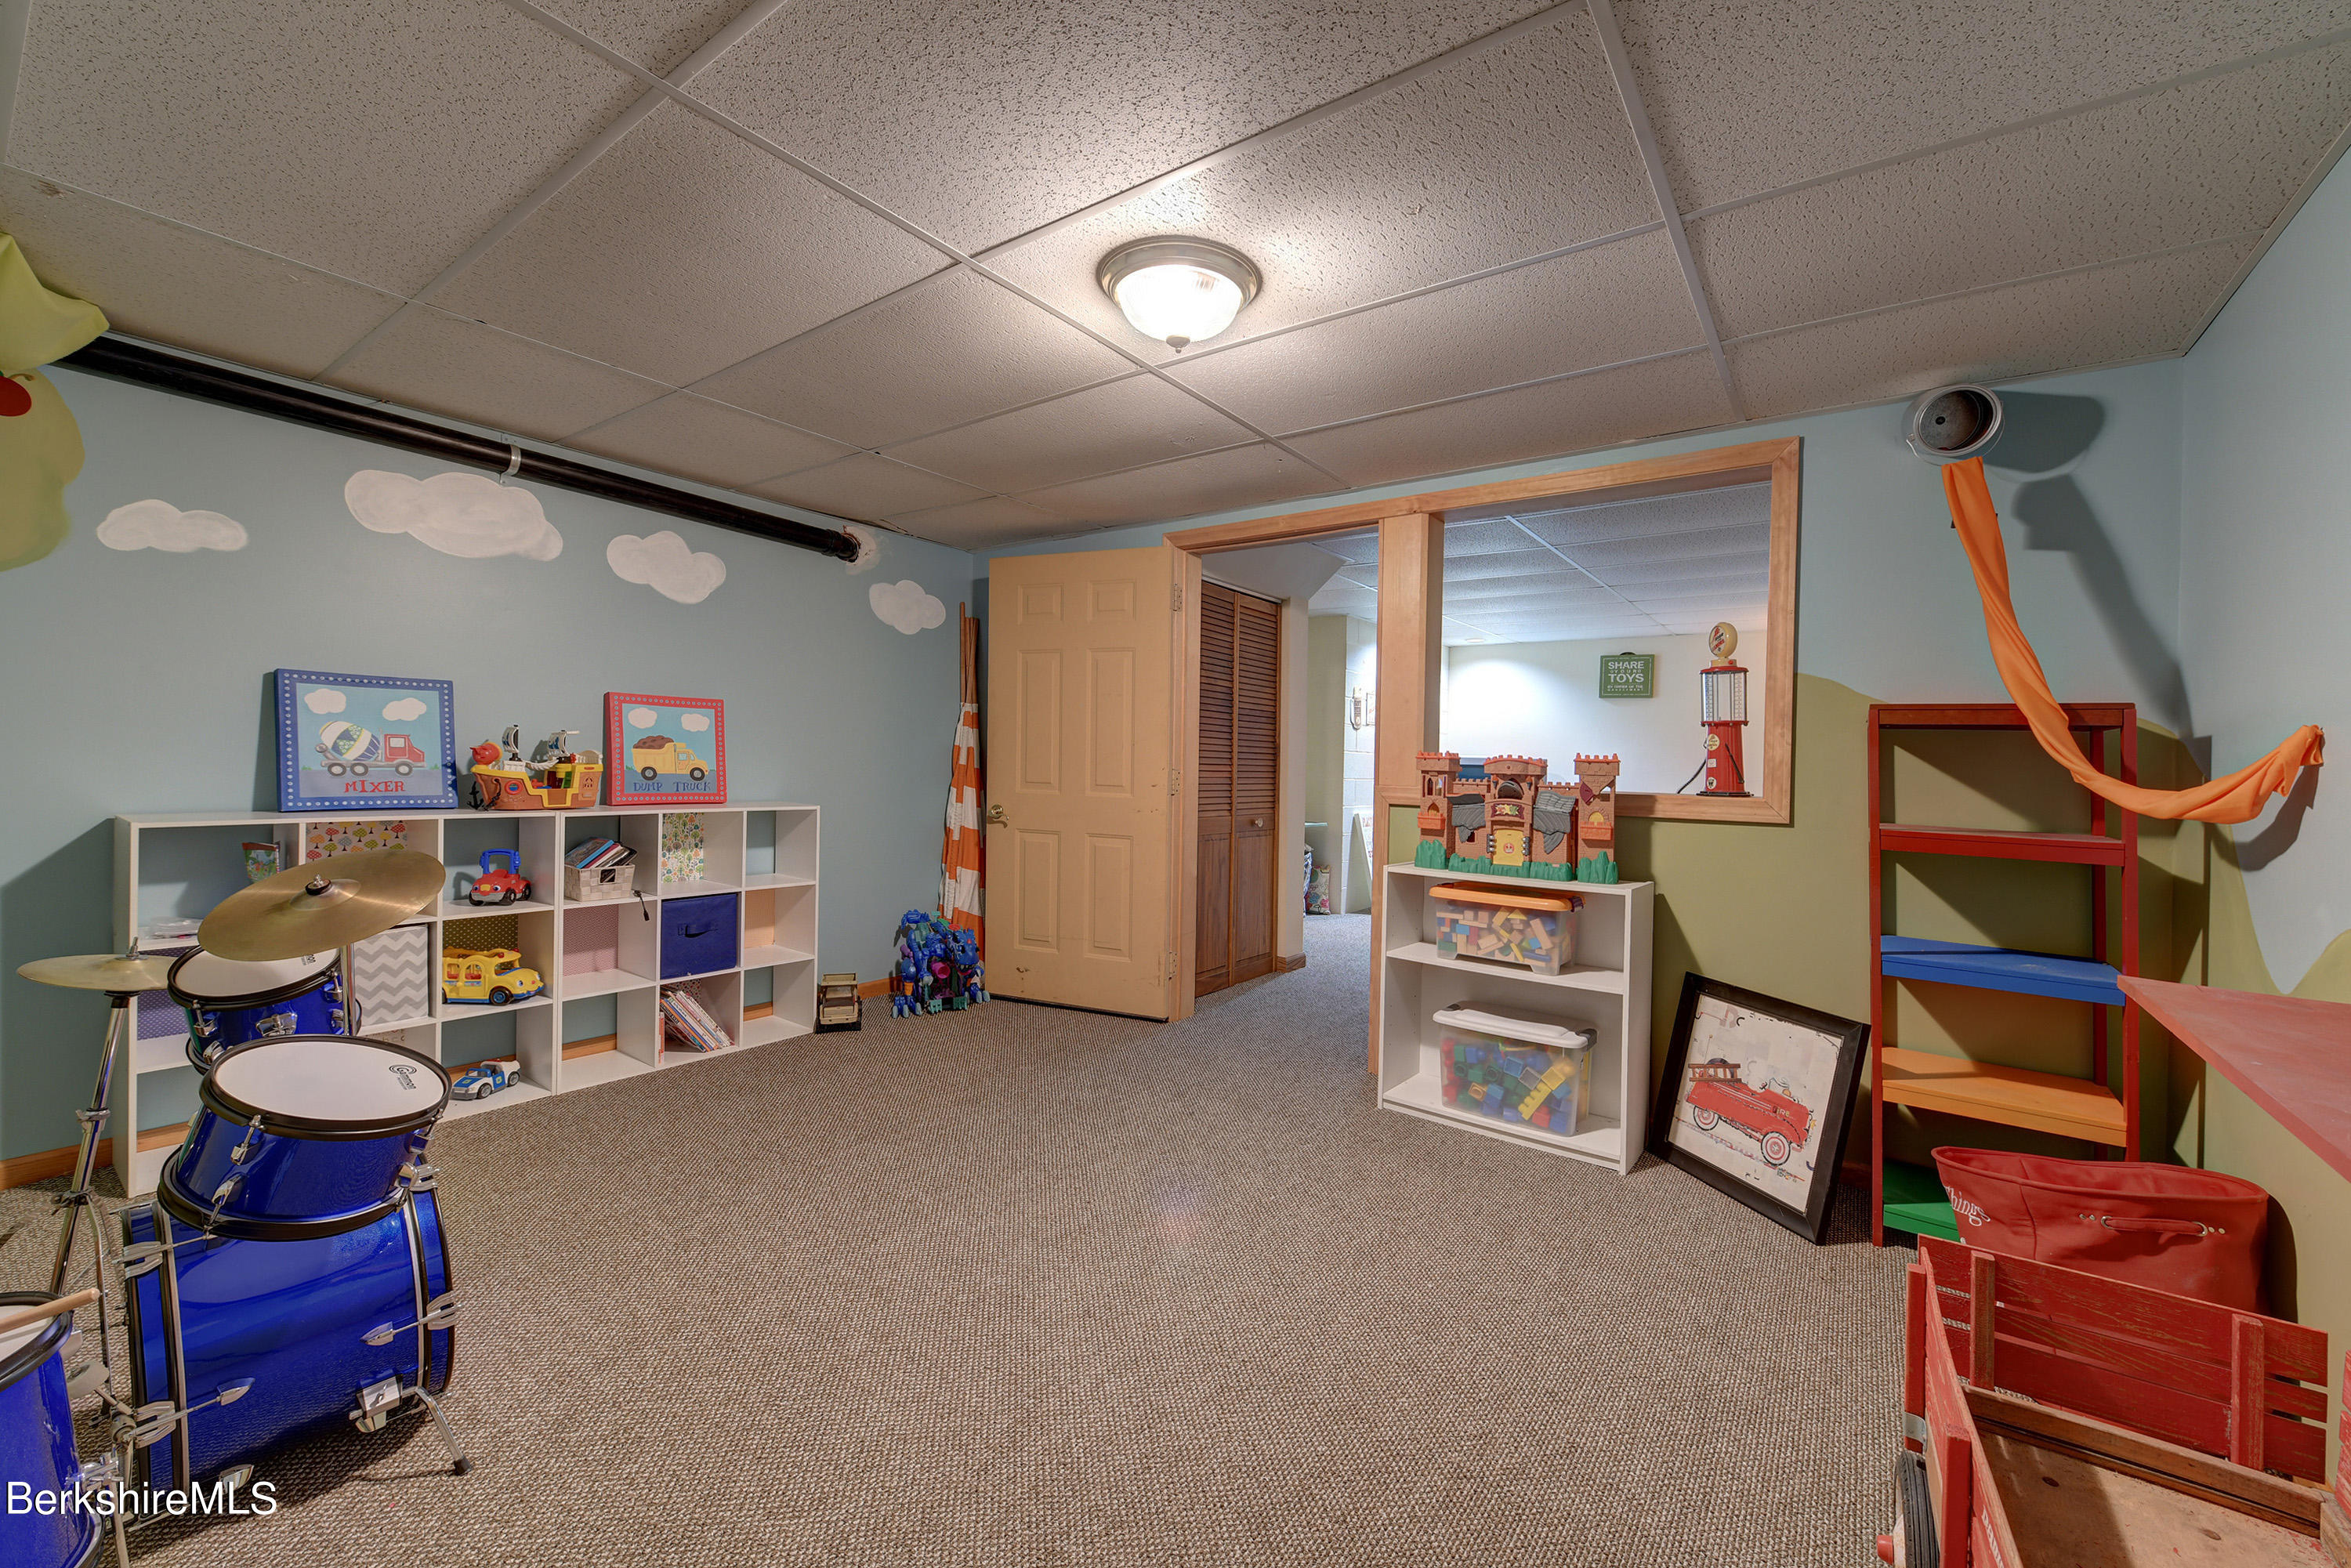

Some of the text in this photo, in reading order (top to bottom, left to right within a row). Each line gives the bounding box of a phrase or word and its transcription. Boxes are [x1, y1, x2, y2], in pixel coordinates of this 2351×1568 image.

[1607, 673, 1644, 683] TOYS
[344, 780, 406, 792] MIXER
[633, 782, 711, 792] DUMP TRUCK
